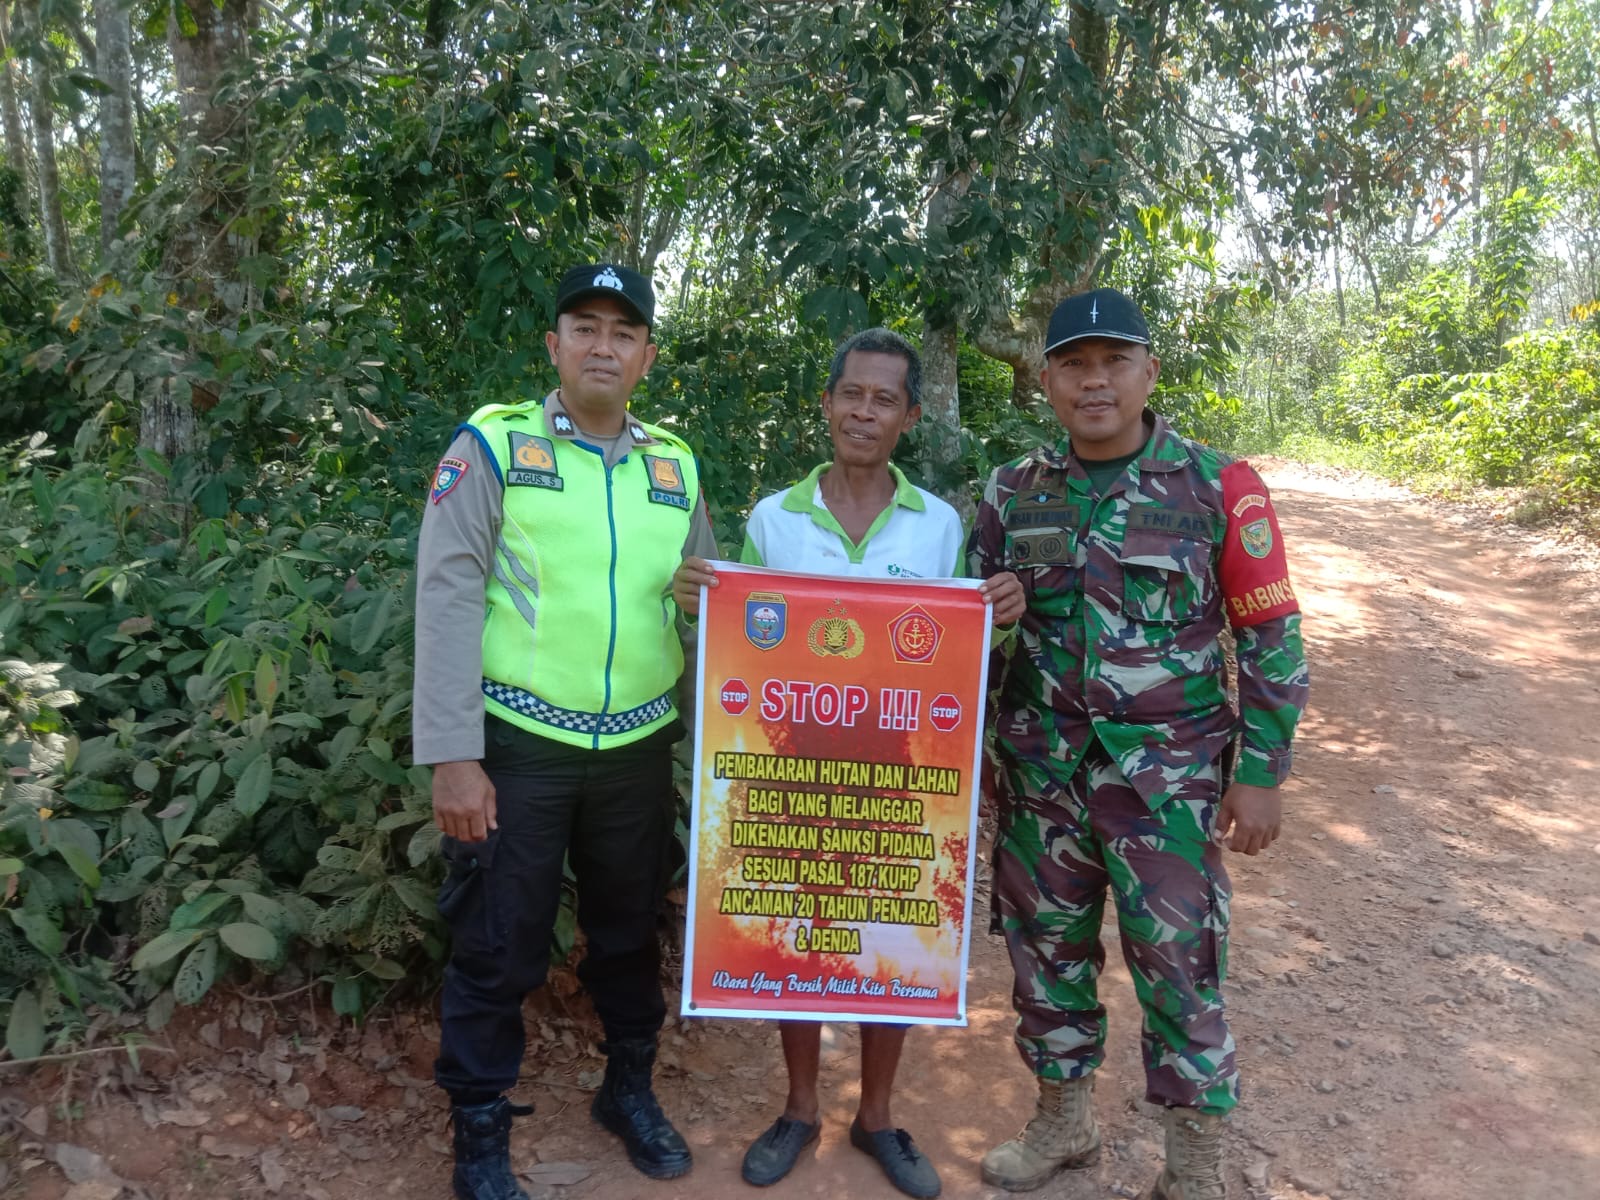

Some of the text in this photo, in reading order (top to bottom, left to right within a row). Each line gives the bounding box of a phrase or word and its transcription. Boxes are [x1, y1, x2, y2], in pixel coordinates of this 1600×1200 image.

[515, 473, 556, 486] AGUS. S
[654, 492, 689, 507] POLRI
[1142, 512, 1173, 528] TNI
[1231, 577, 1296, 617] BABINS
[722, 691, 748, 702] STOP
[759, 678, 922, 732] STOP !!!
[931, 707, 959, 719] STOP
[715, 752, 959, 795] PEMBAKARAN HUTAN DAN LAHAN
[747, 788, 922, 825] BAGI YANG MELANGGAR
[732, 822, 934, 860] DIKENAKAN SANKSI PIDANA
[743, 856, 920, 891] SESUAI PASAL 187 KUHP
[720, 888, 938, 926] ANCAMAN 20 TAHUN PENJARA
[796, 926, 860, 954] & DENDA
[711, 970, 938, 1000] Udara Yang Bersih Milik Kita Bersama
